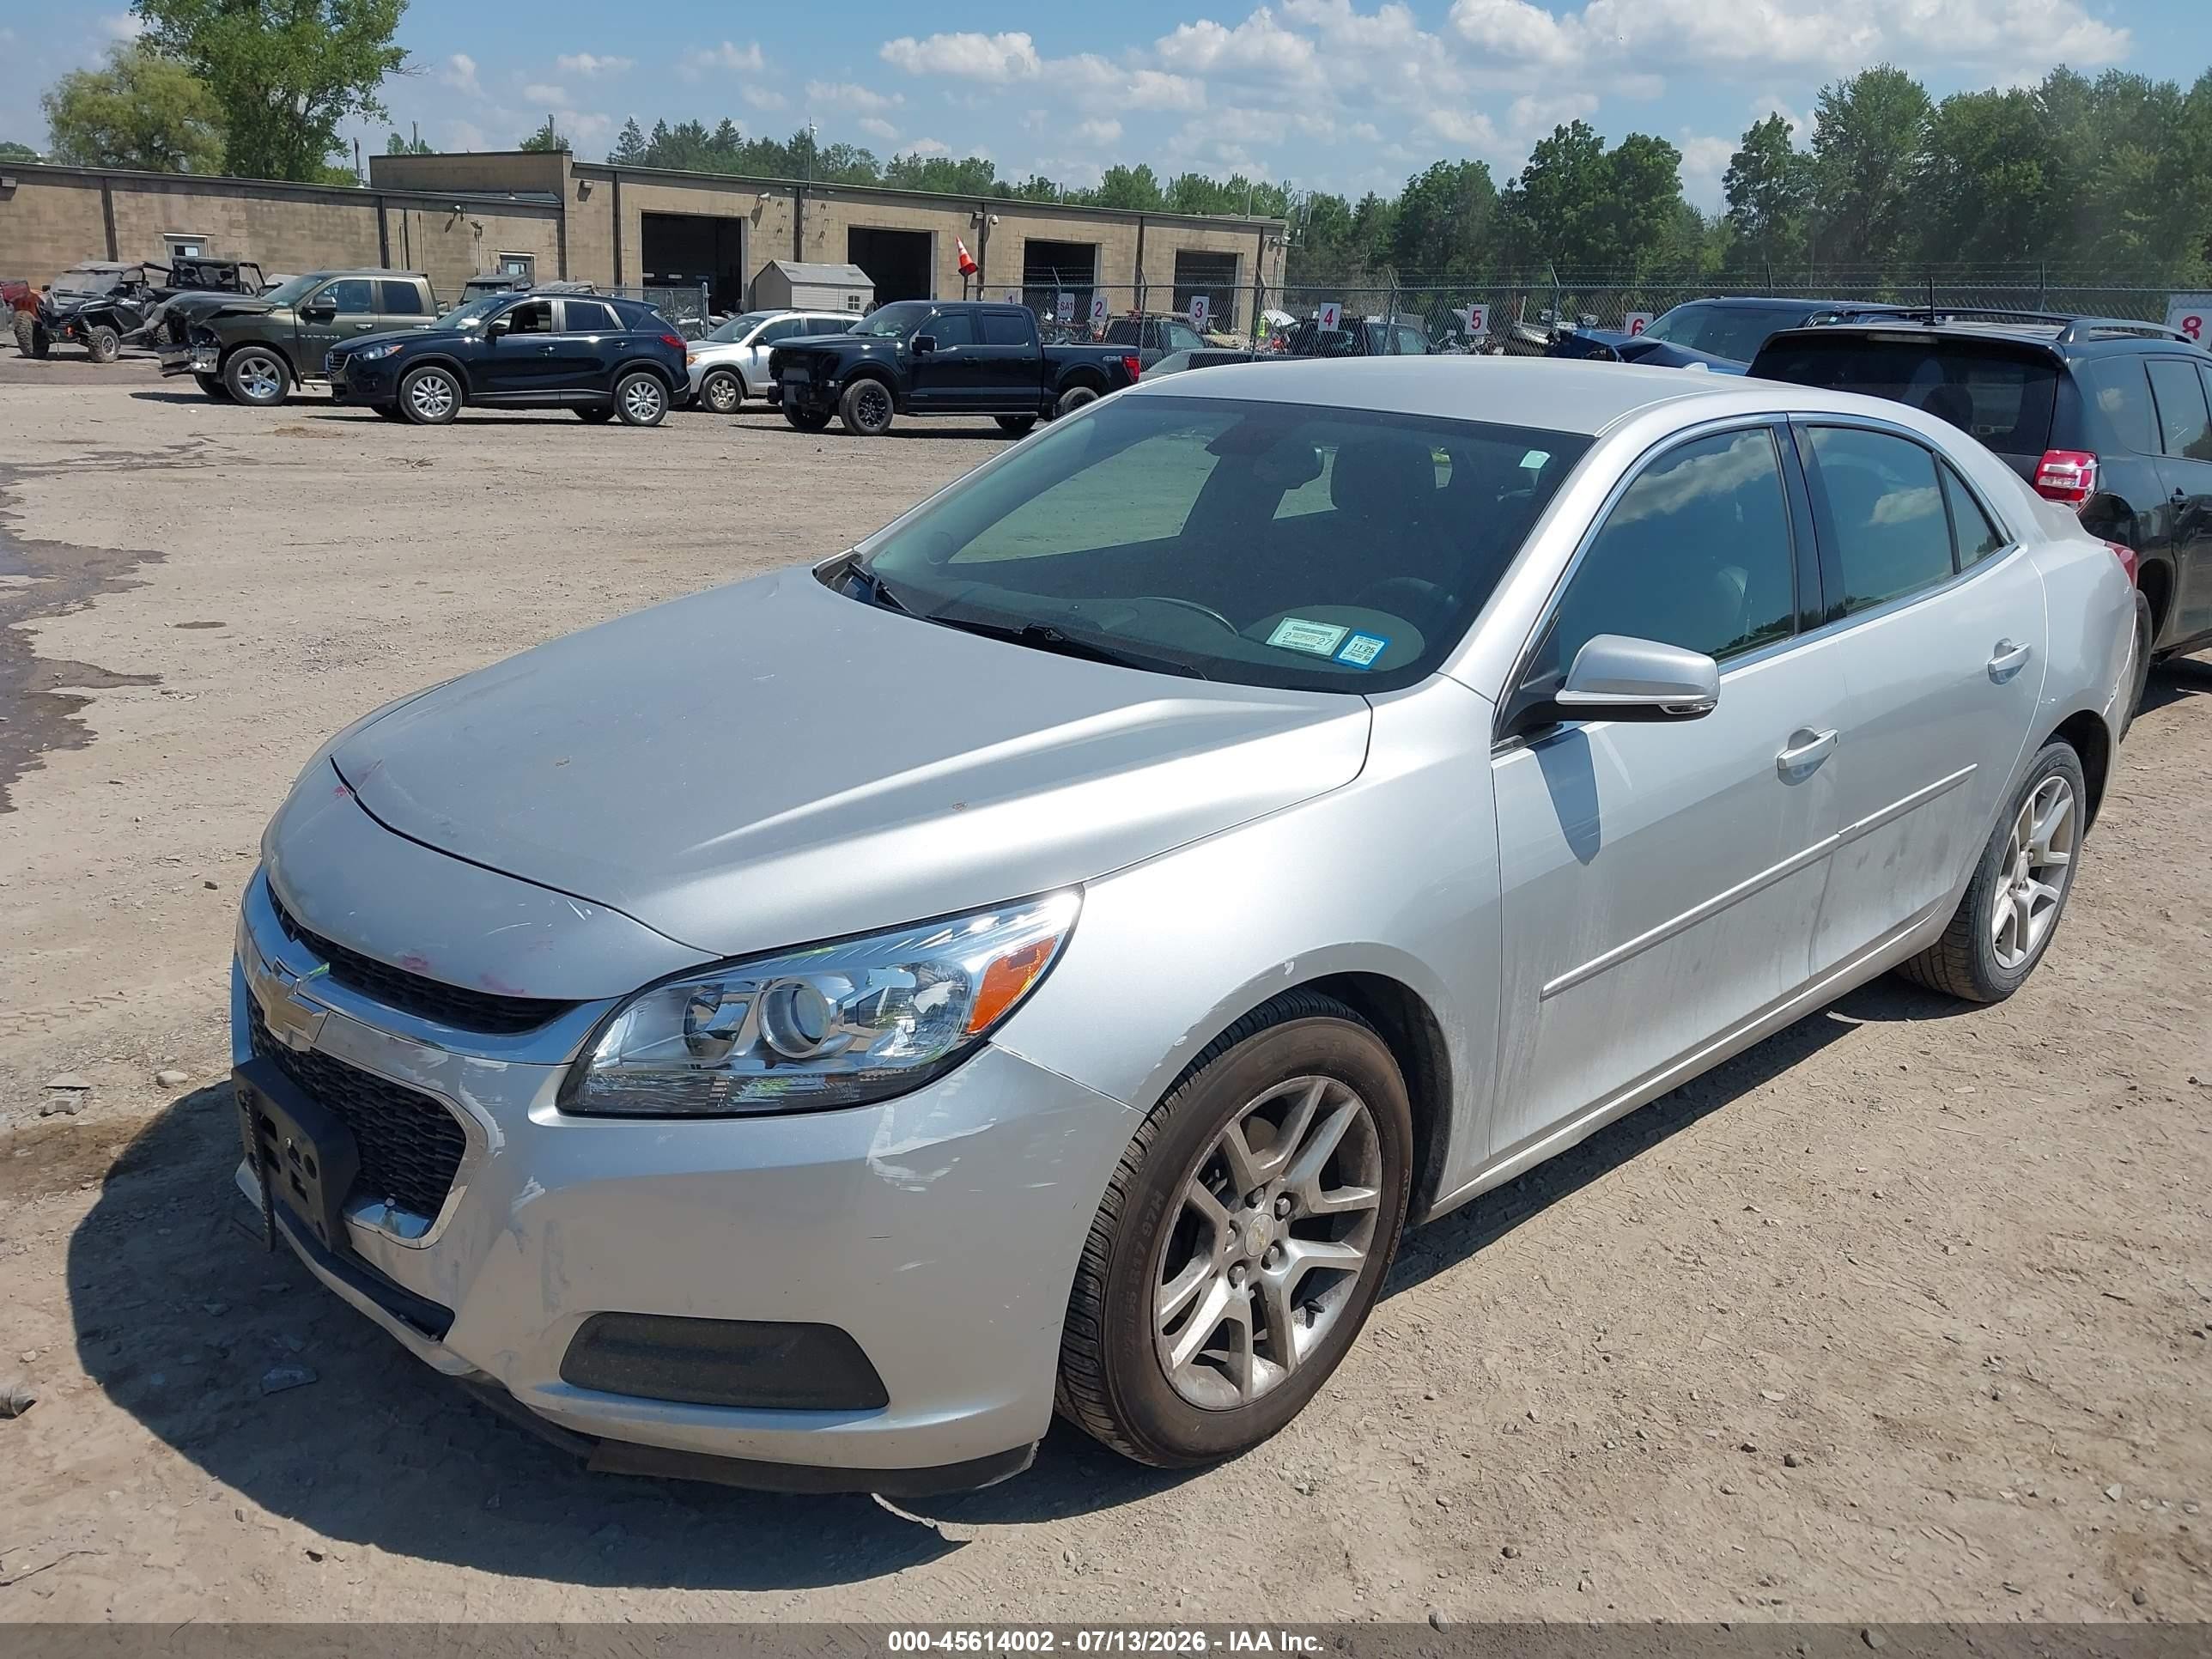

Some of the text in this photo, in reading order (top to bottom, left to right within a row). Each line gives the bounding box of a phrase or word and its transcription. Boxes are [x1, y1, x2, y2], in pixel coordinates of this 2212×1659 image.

[1095, 301, 1103, 318] 2
[1194, 301, 1204, 319] 3
[1323, 308, 1334, 326] 4
[1471, 310, 1482, 330] 5
[1632, 318, 1644, 337] 6
[2182, 315, 2203, 341] 8
[1282, 631, 1292, 640] 2
[1316, 637, 1334, 647] 27
